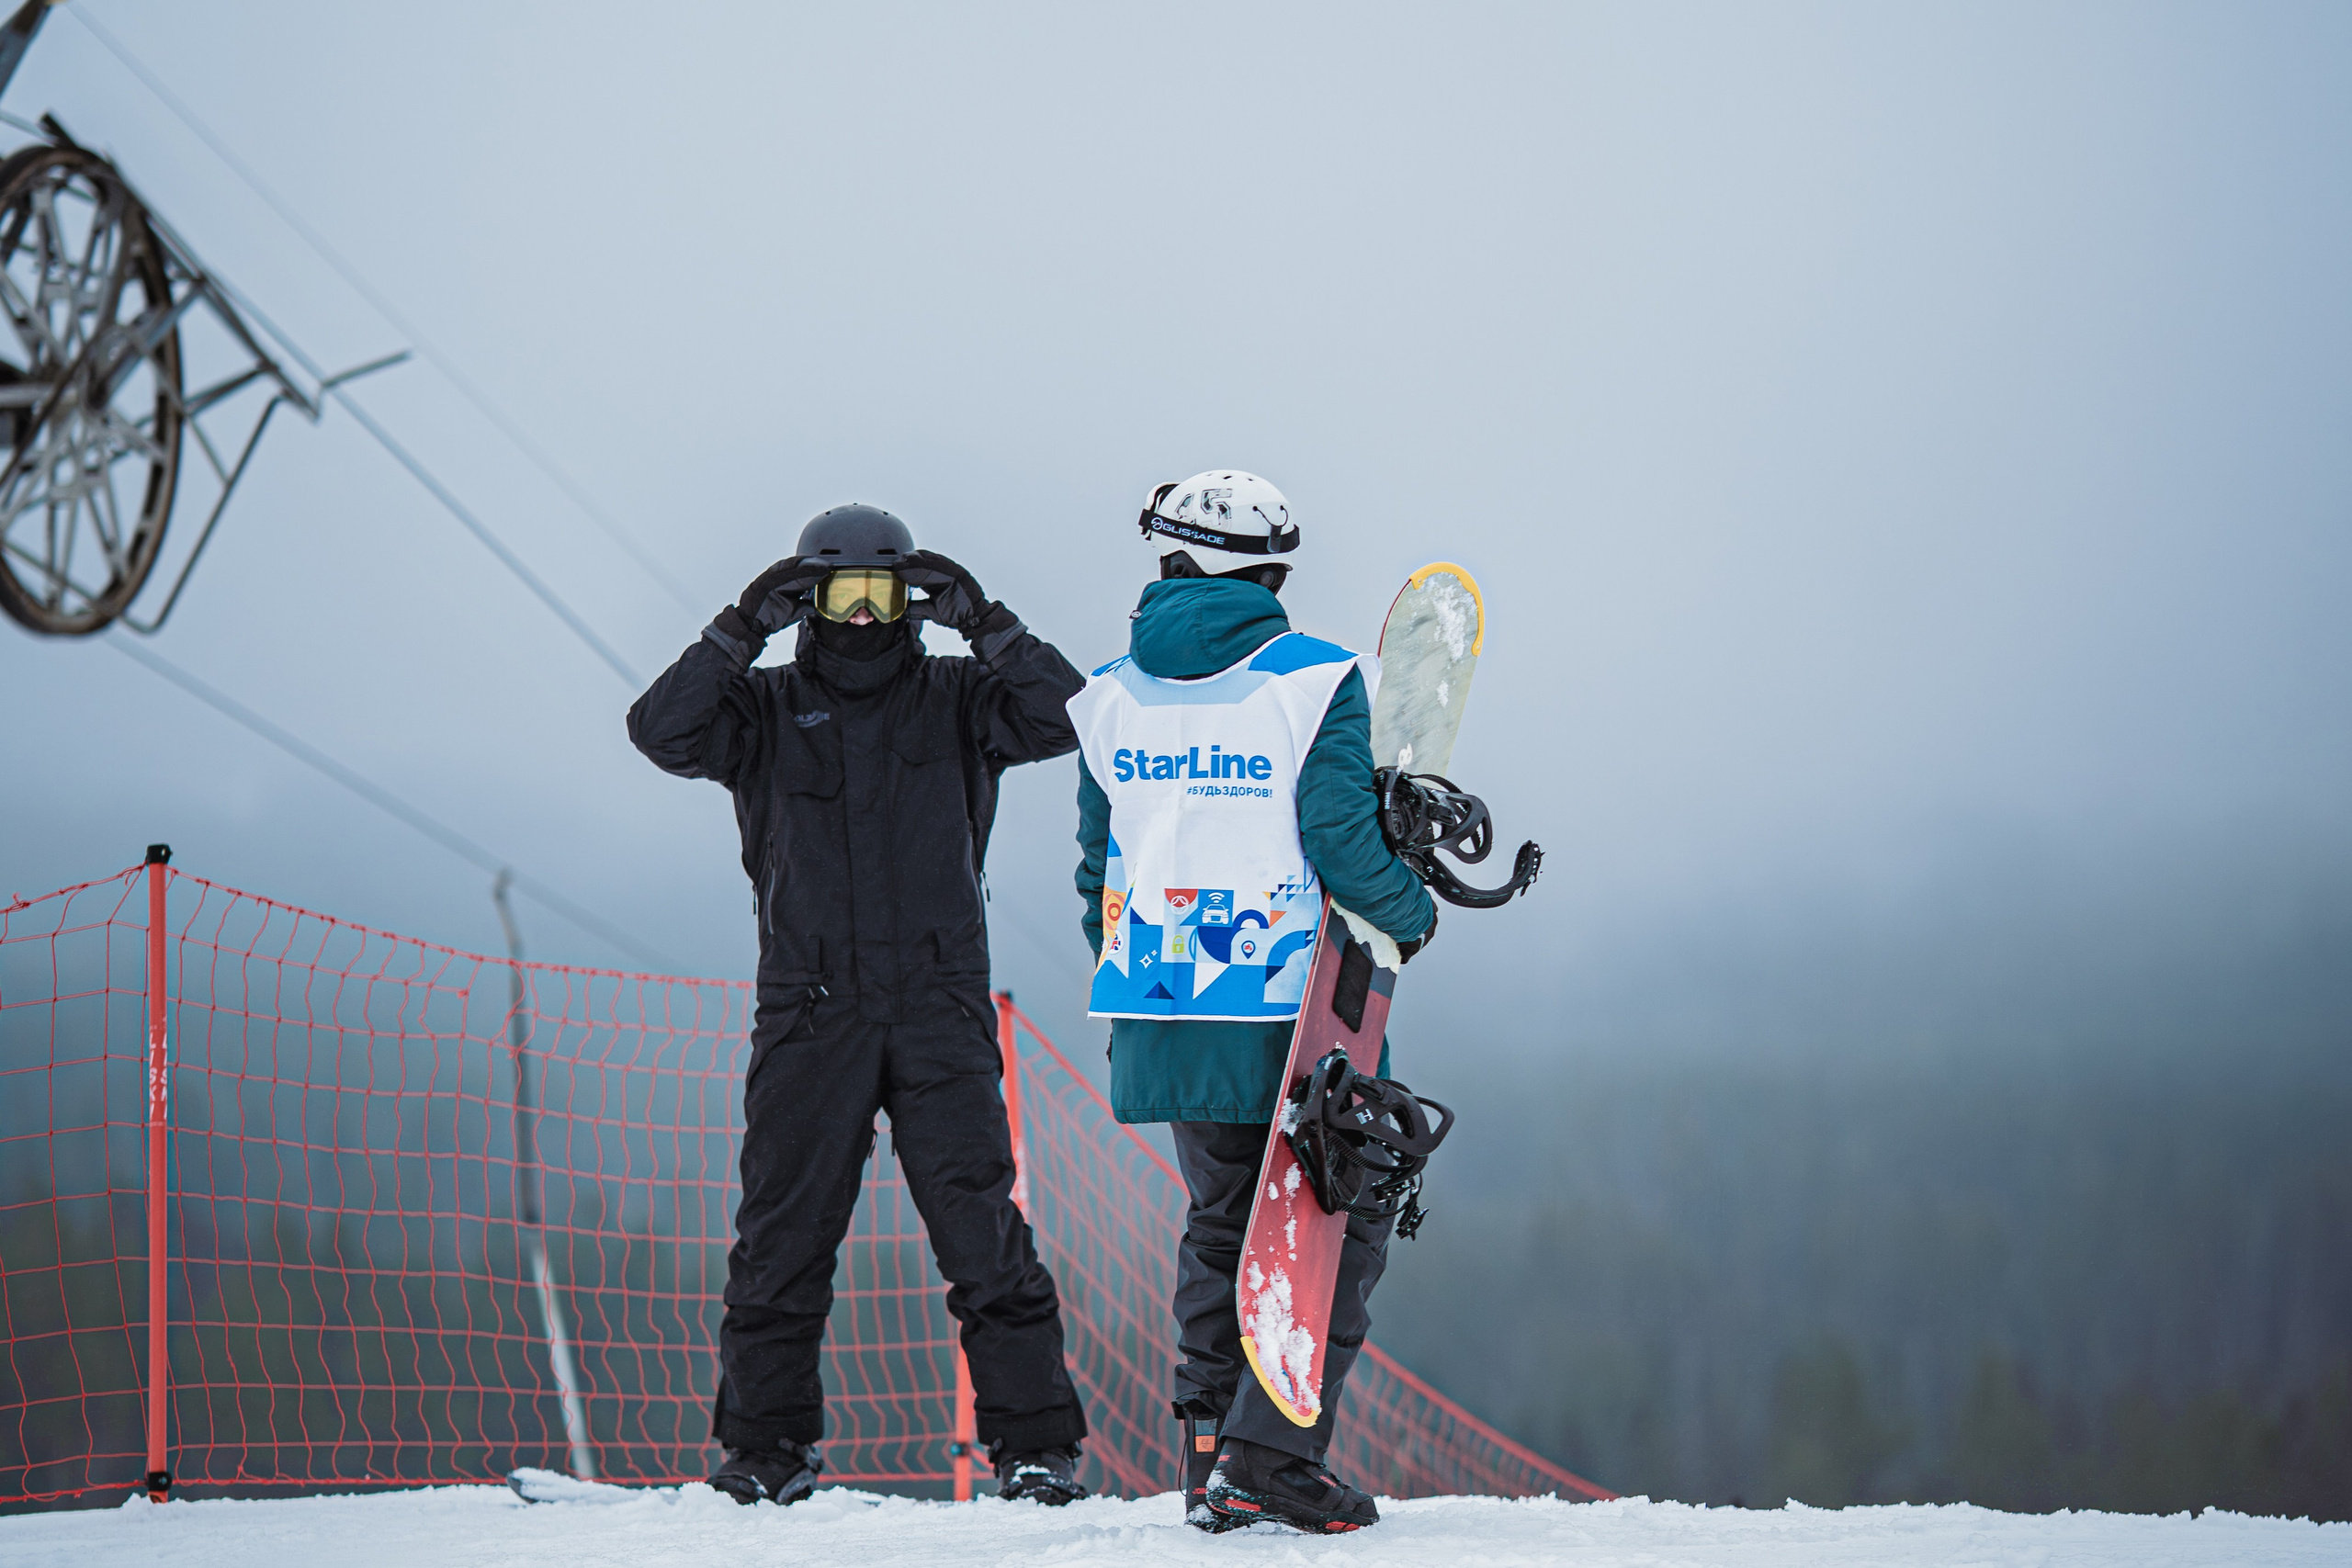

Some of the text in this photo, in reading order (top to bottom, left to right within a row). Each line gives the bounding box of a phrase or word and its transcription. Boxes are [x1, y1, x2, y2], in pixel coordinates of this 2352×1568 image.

[1162, 523, 1226, 545] GLISSADE
[1114, 745, 1272, 782] StarLine
[1186, 785, 1272, 798] #БУДЬЗДОРОВ!
